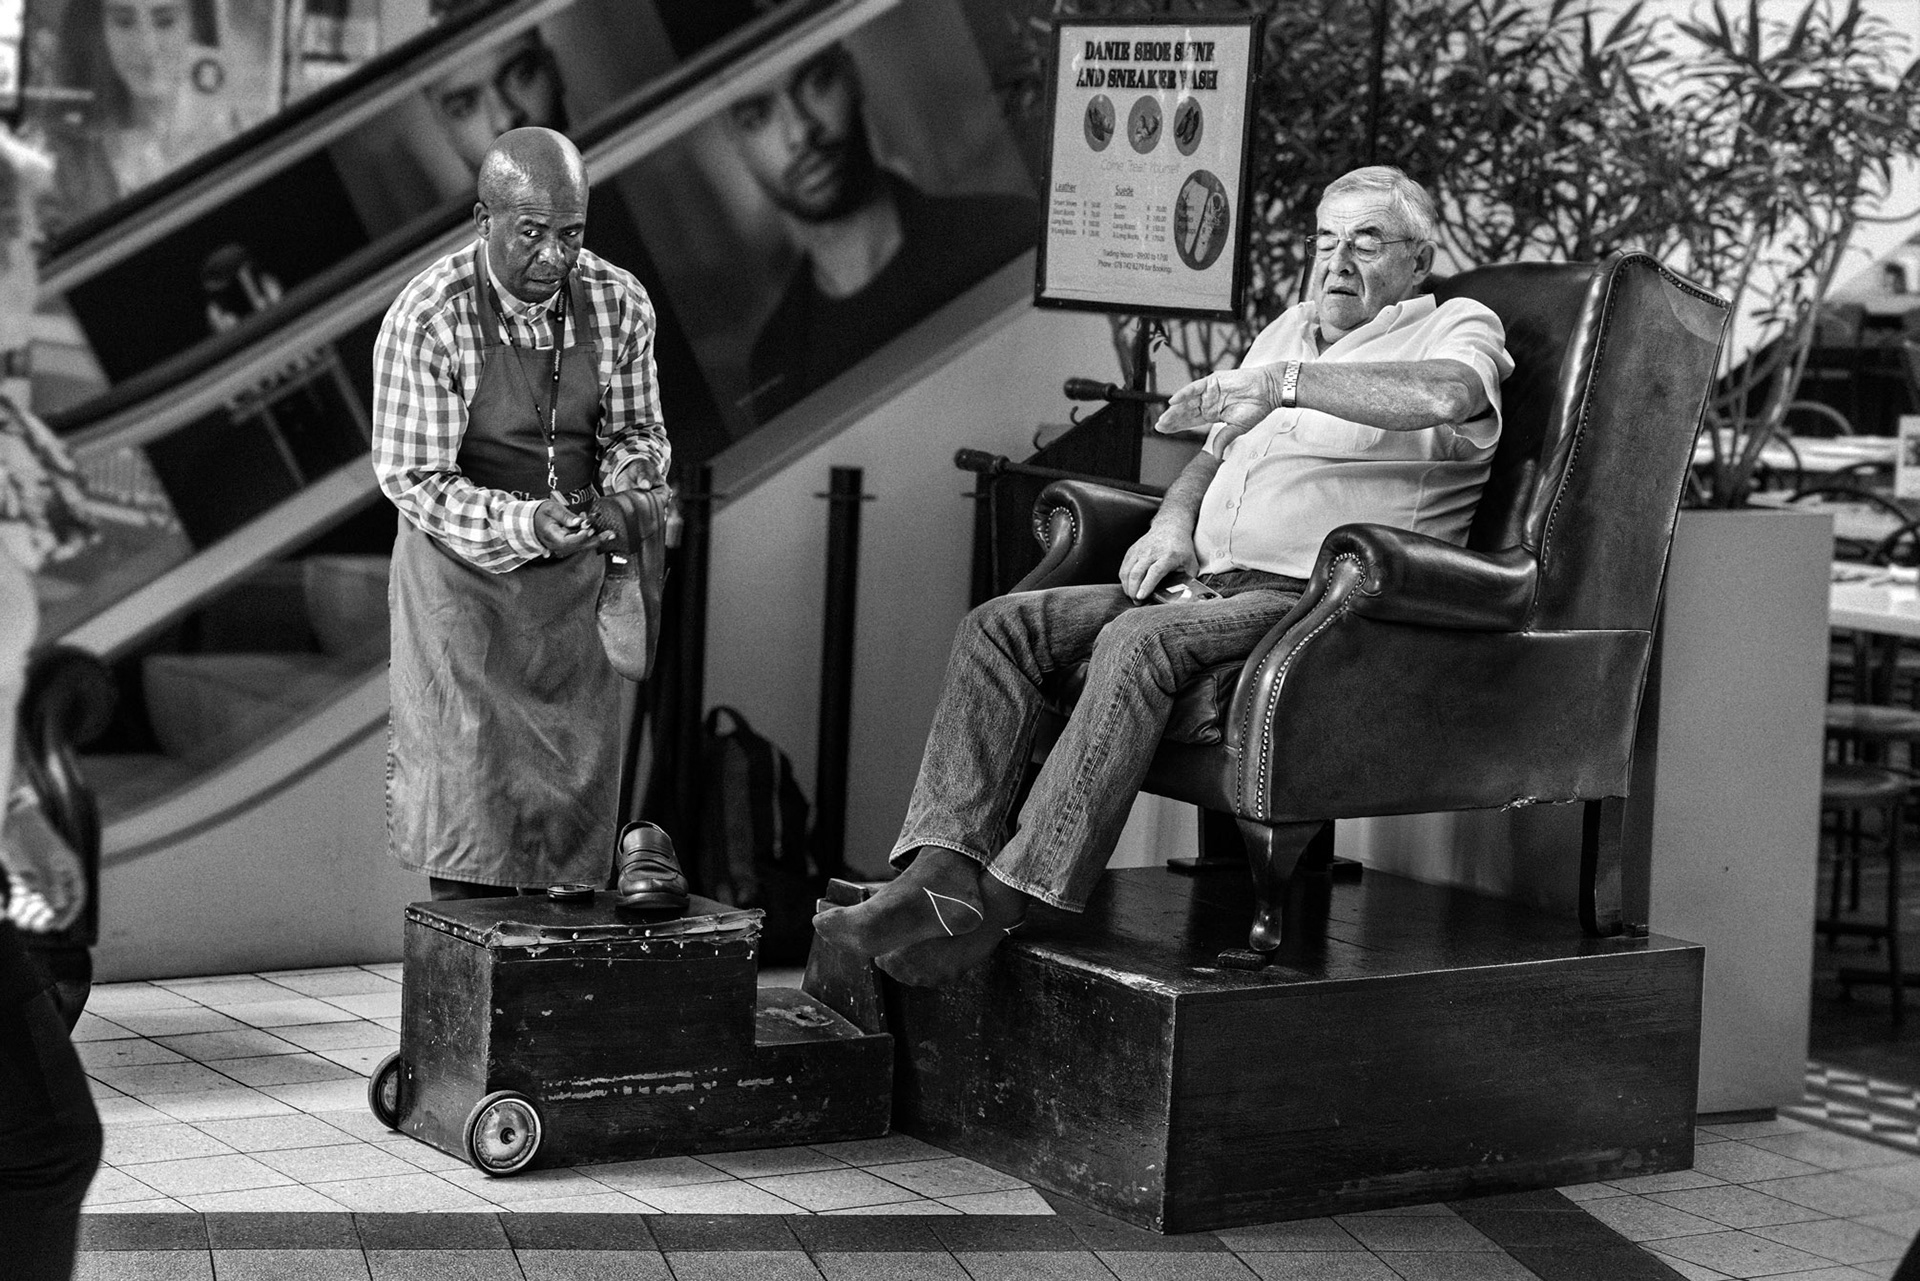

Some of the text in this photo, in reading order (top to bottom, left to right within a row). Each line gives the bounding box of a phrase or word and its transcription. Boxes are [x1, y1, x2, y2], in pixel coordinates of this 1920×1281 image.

[1085, 41, 1215, 61] DANIE SHOE SNE
[1076, 68, 1106, 87] AND
[1107, 69, 1176, 89] SNEAKER
[1055, 182, 1077, 193] Leather
[1115, 185, 1134, 197] Suede
[1103, 249, 1120, 260] Trading
[1120, 251, 1134, 259] Hours
